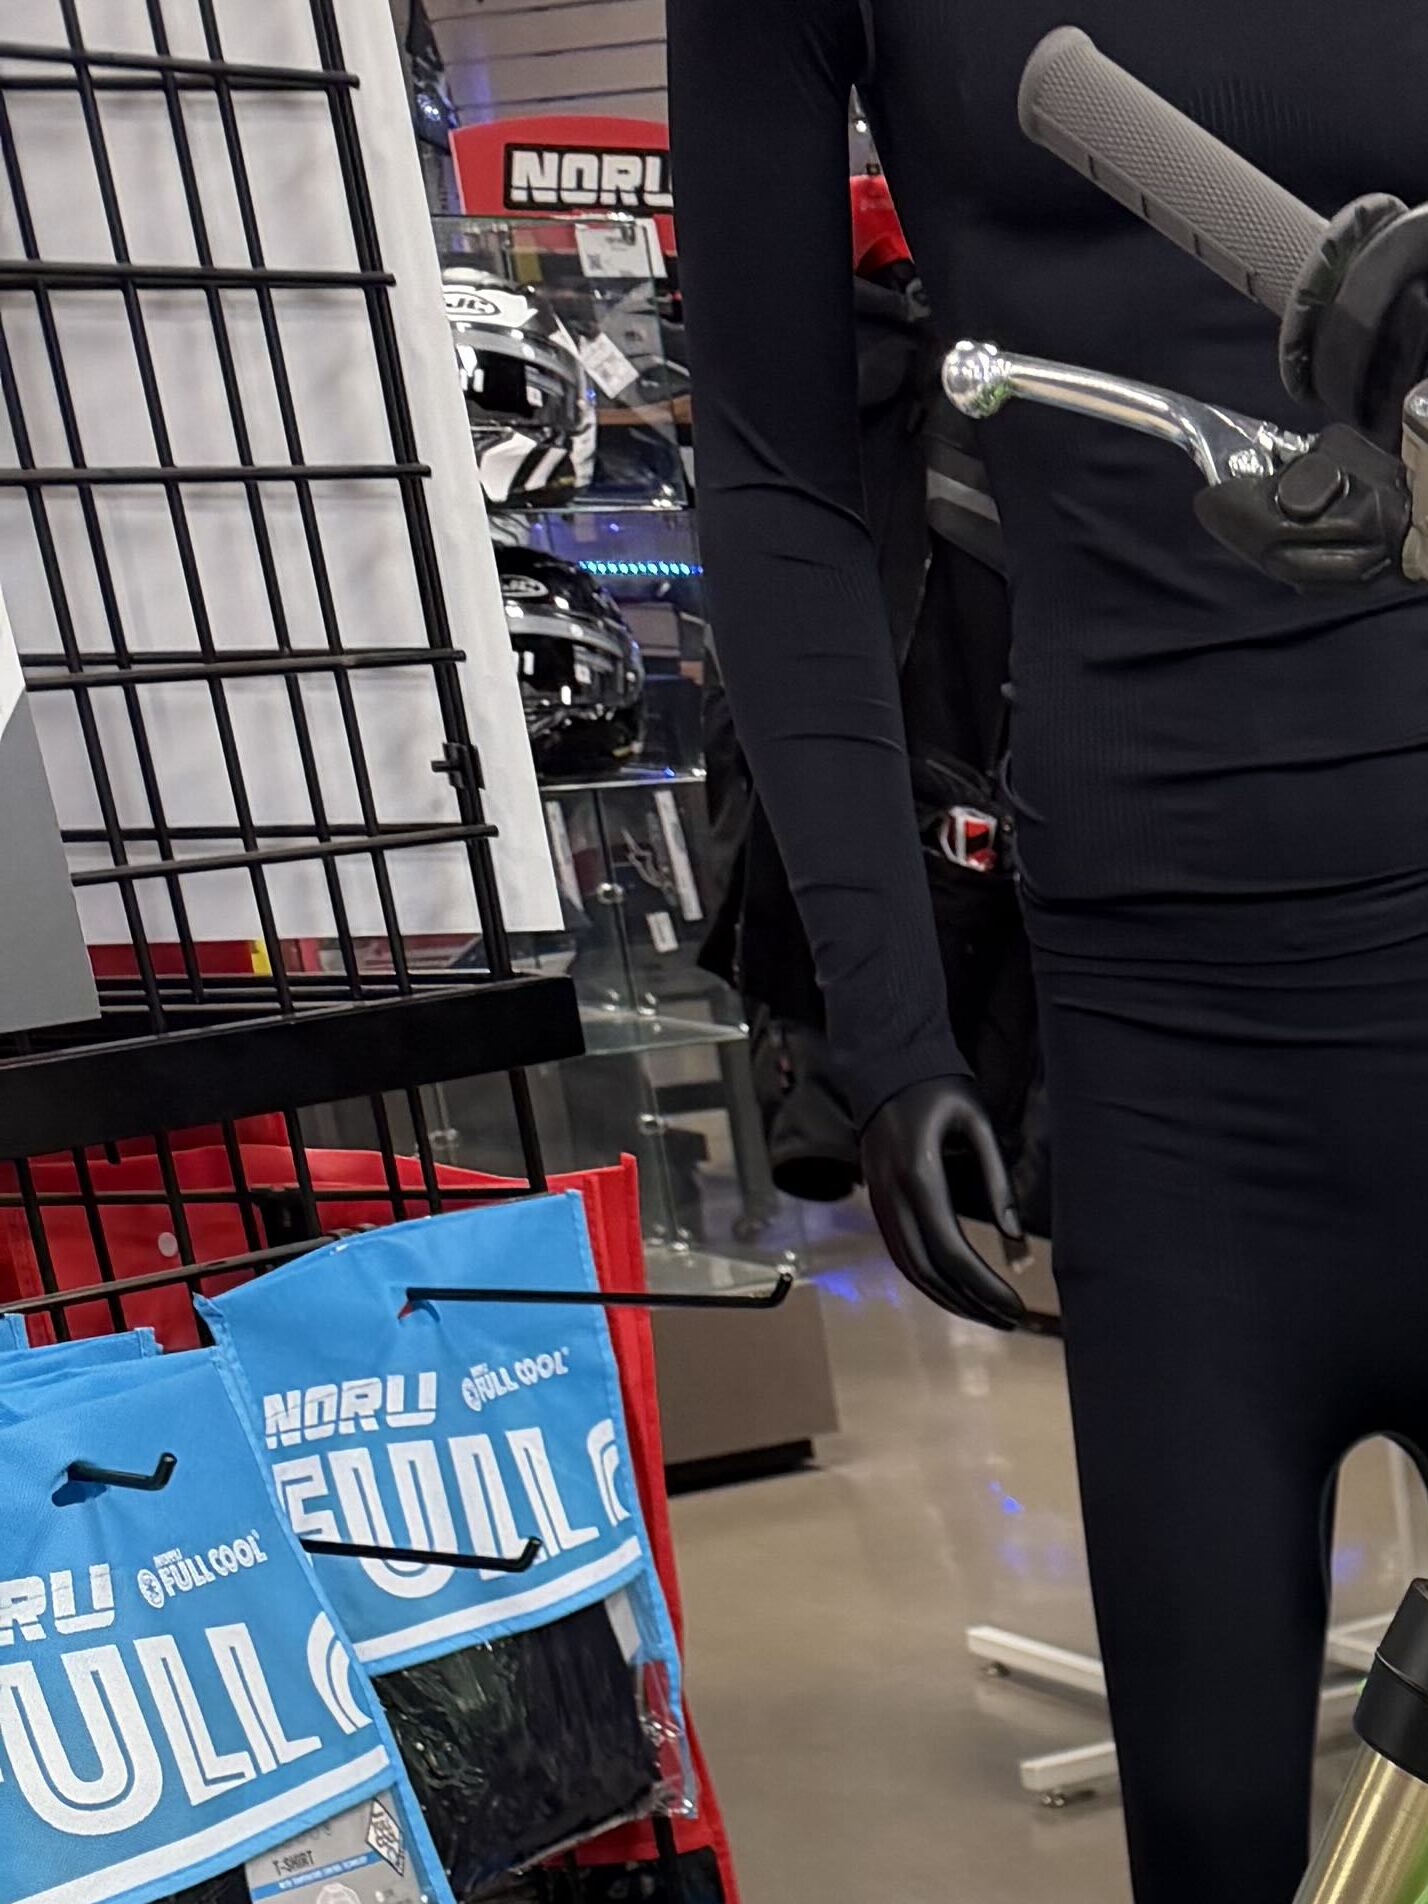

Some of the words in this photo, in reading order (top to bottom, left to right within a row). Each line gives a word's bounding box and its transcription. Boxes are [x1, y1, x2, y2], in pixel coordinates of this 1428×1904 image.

[263, 1371, 437, 1450] NORU
[272, 1426, 599, 1599] FULL
[0, 1563, 116, 1646] RU
[158, 1555, 216, 1597] FULL
[208, 1535, 268, 1577] COOL
[0, 1623, 322, 1836] ULL
